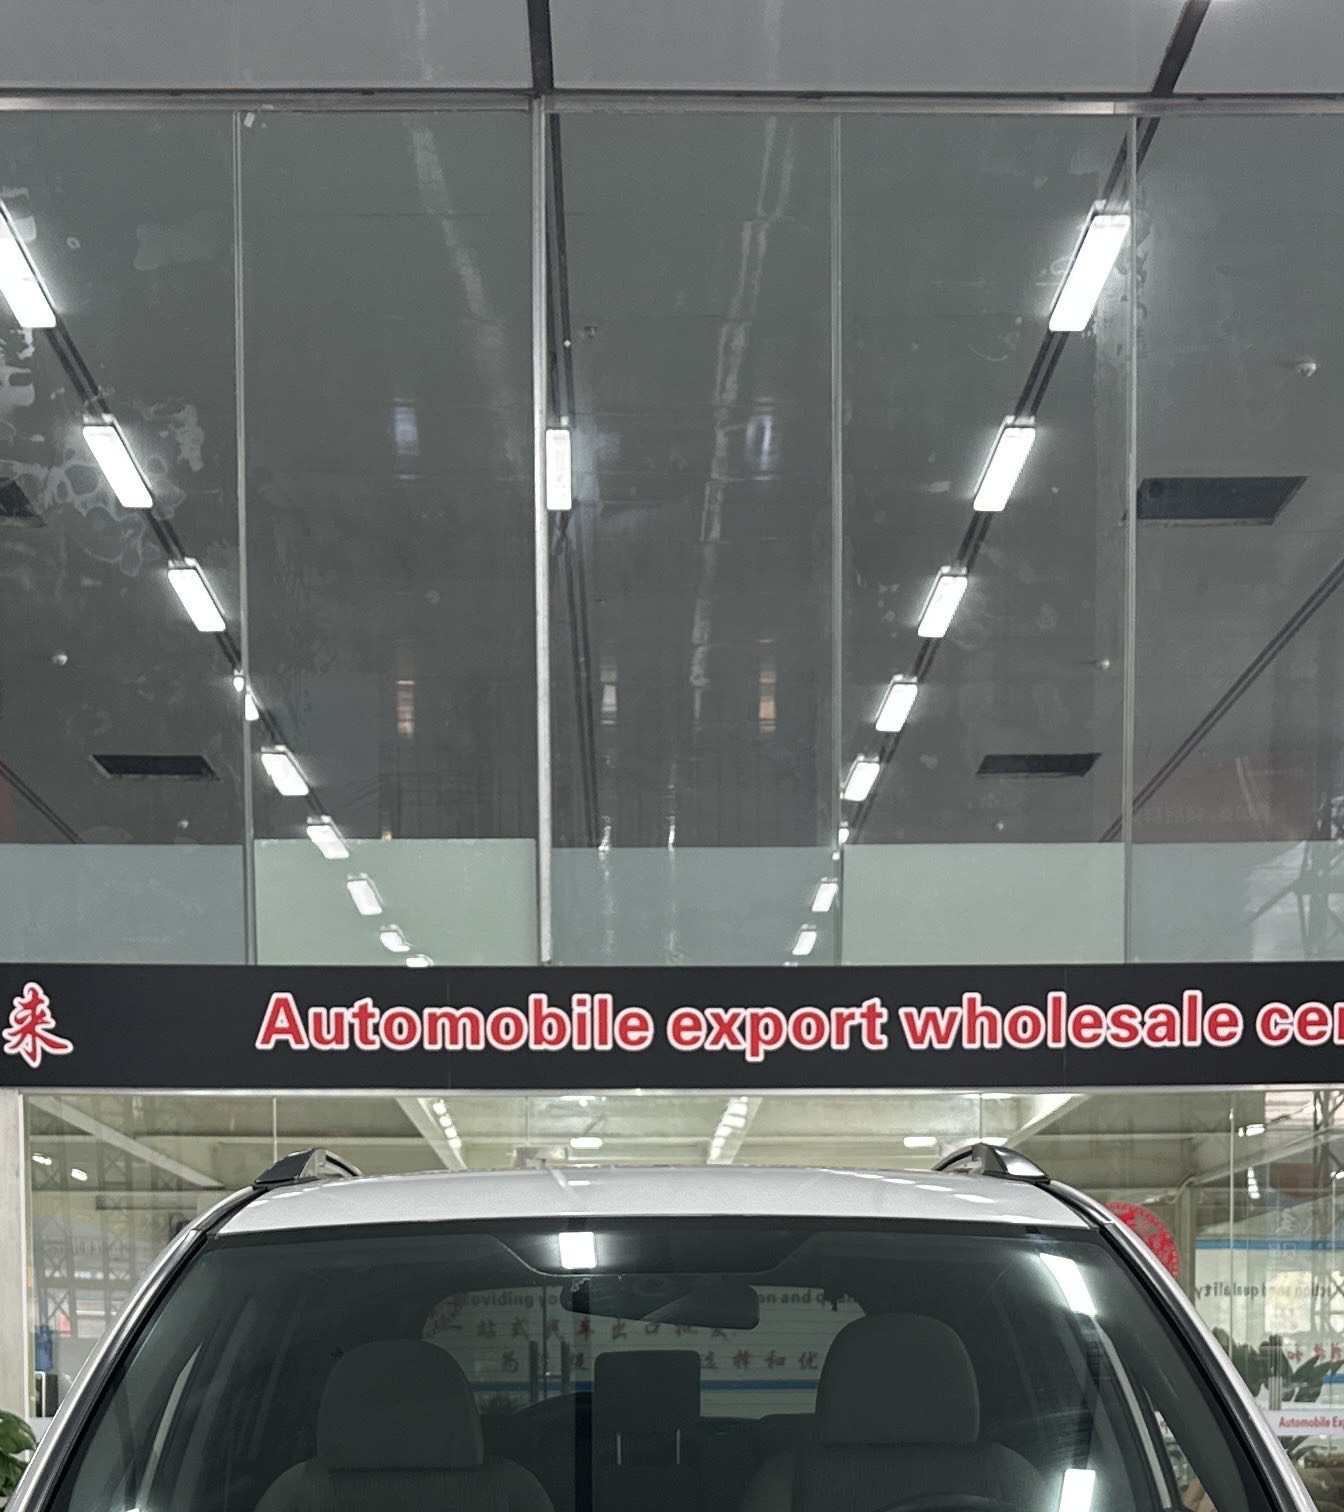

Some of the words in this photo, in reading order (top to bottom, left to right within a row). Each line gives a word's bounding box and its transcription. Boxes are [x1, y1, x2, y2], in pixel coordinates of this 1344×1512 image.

[254, 991, 654, 1052] Automobile
[666, 996, 889, 1062] export
[897, 990, 1244, 1051] wholesale
[1279, 1416, 1330, 1428] Automobile
